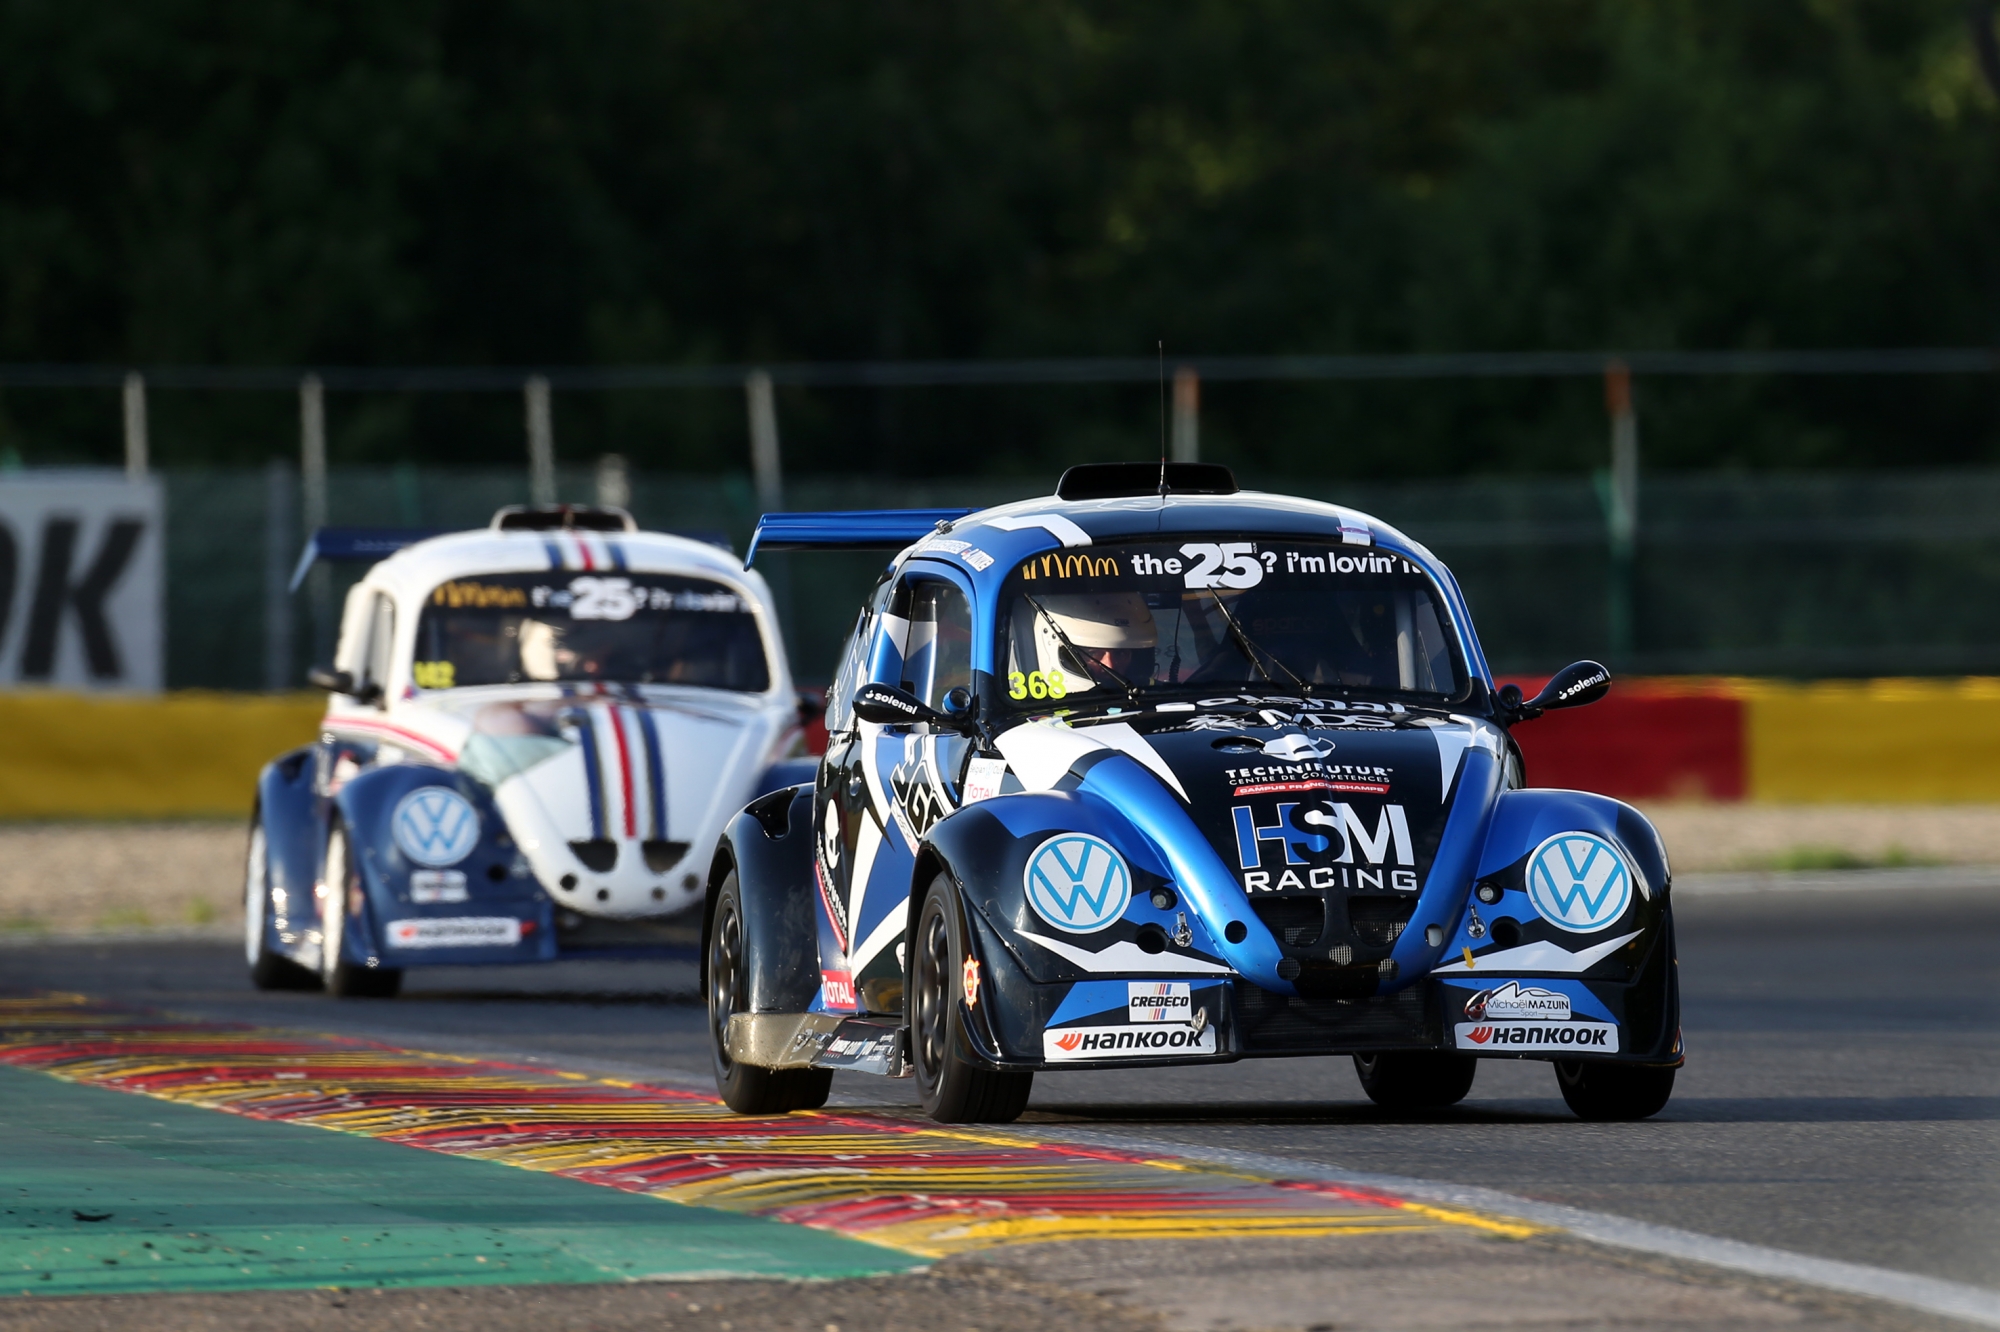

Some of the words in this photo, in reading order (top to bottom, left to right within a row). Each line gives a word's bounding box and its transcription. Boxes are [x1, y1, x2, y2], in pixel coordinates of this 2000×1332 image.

[1131, 554, 1182, 575] the
[1286, 552, 1326, 574] i'm
[1329, 552, 1397, 574] lovin'
[1008, 671, 1067, 700] 368
[1567, 671, 1605, 696] solenal
[874, 692, 918, 715] solenal
[1229, 776, 1276, 786] CENTRE
[1302, 772, 1390, 783] COMPETENCES
[1239, 785, 1287, 794] CAMPUS
[1231, 800, 1415, 870] HSM
[1244, 867, 1418, 893] RACING
[1131, 996, 1189, 1007] CREDECO
